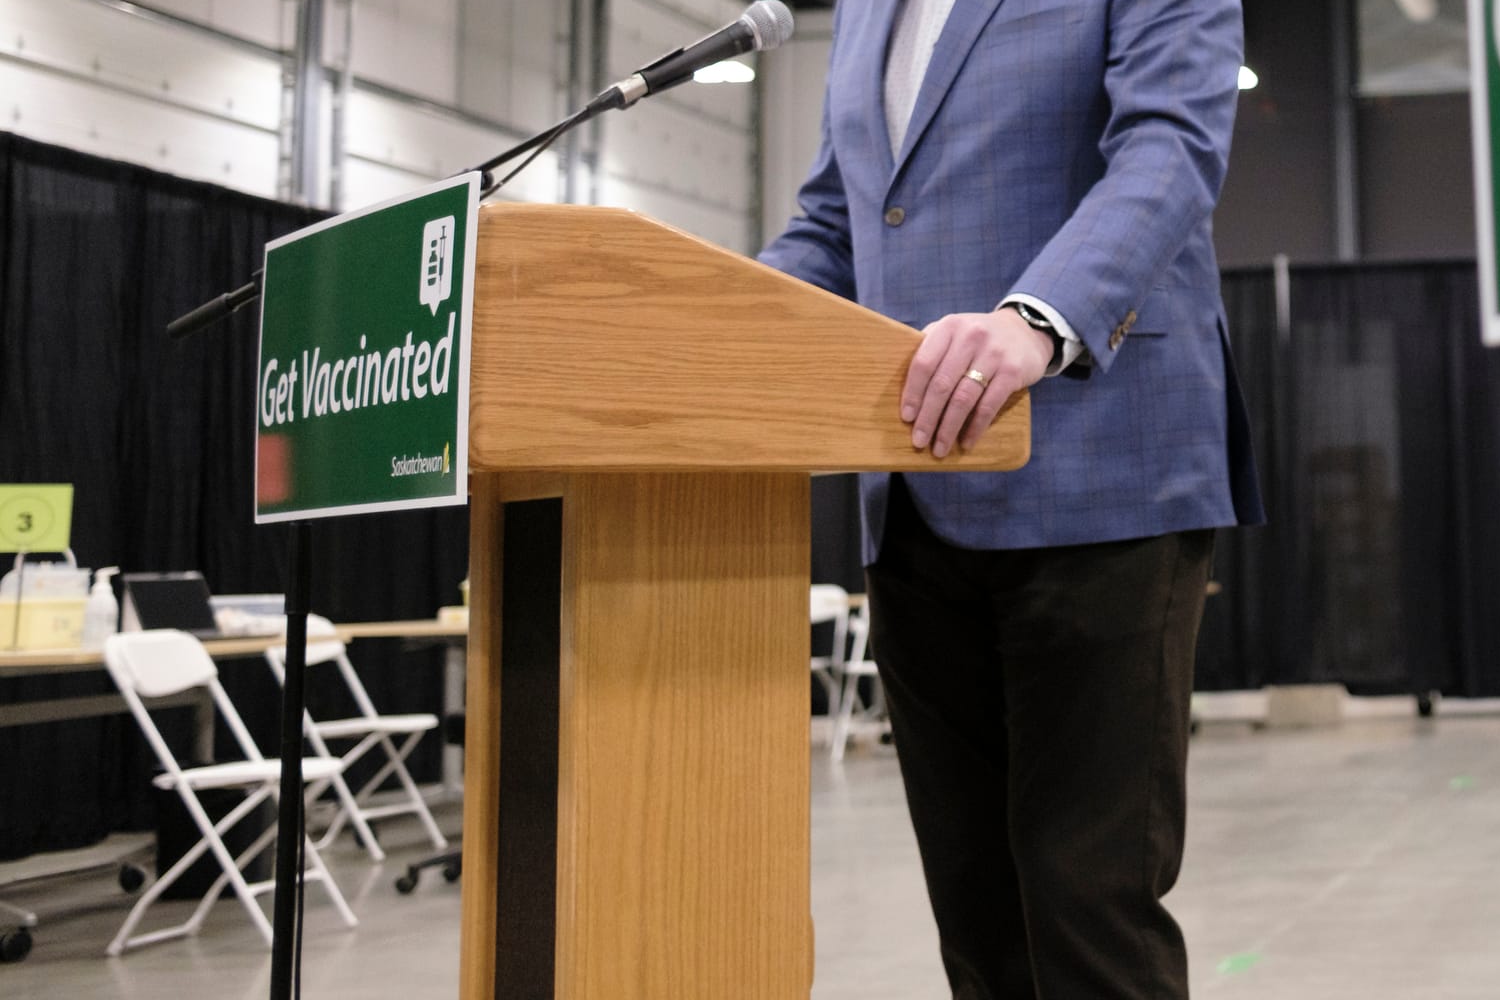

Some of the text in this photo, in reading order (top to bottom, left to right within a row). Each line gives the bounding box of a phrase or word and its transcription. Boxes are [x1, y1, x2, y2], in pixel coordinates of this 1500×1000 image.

[261, 311, 456, 427] Get Vaccinated
[391, 452, 443, 477] Saskatchewan
[16, 511, 34, 533] 3
